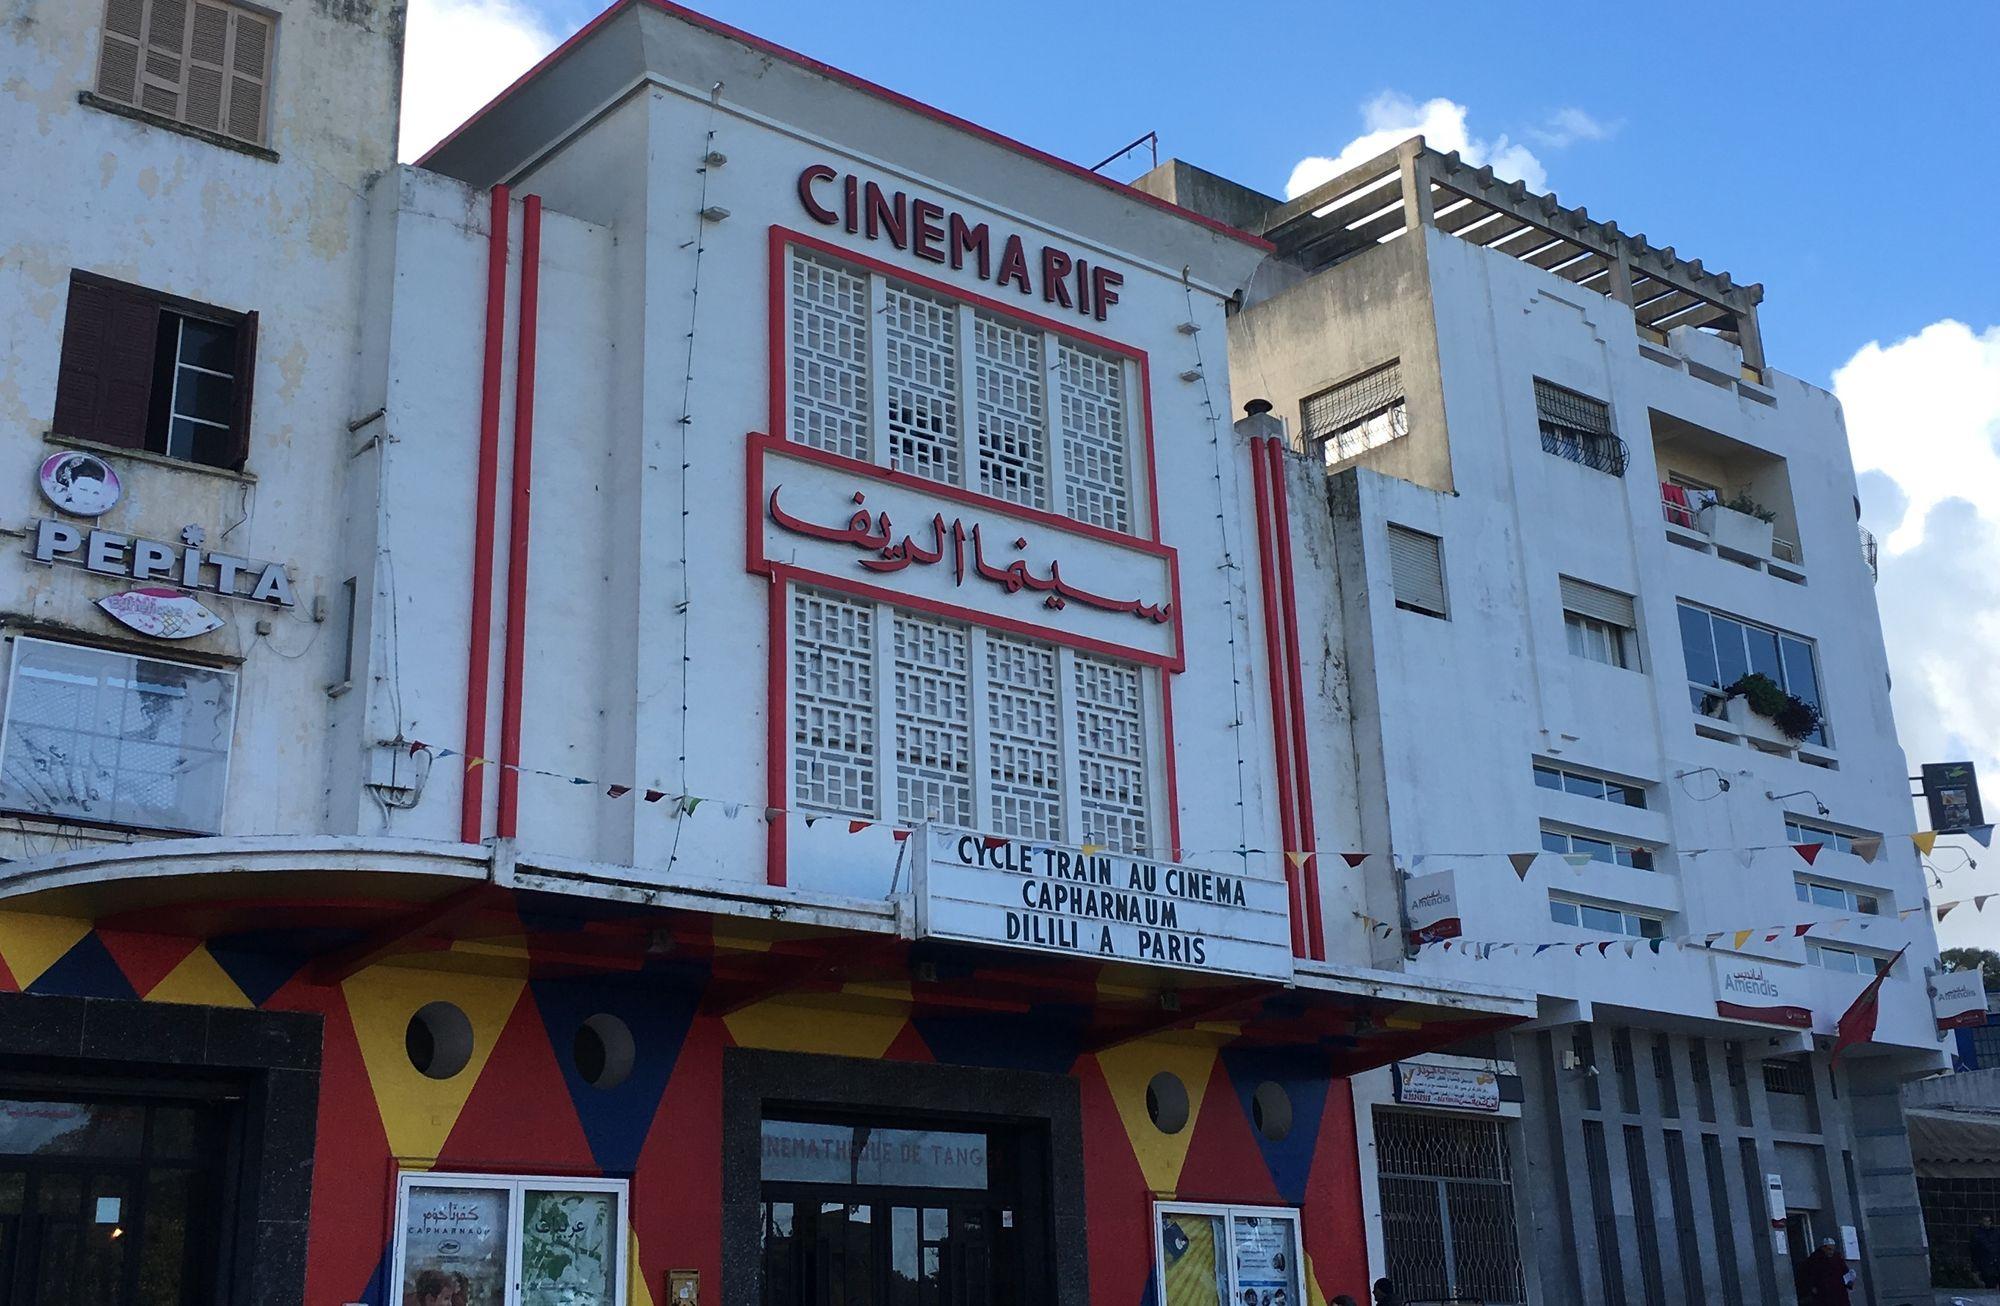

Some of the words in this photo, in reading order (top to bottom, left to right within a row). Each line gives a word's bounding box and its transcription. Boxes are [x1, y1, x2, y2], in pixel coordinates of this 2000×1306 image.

[769, 484, 965, 586] الريف
[974, 523, 1173, 624] سينما
[958, 835, 1033, 874] CYCLE
[1044, 849, 1111, 885] TRAIN
[1129, 862, 1157, 892] AU
[1165, 869, 1246, 907] CINEMA
[1023, 880, 1178, 929] CAPHARNAUM
[1007, 912, 1078, 949] DILILI
[1100, 925, 1114, 953] A
[1139, 931, 1206, 965] PARIS
[1726, 974, 1779, 997] Amendis
